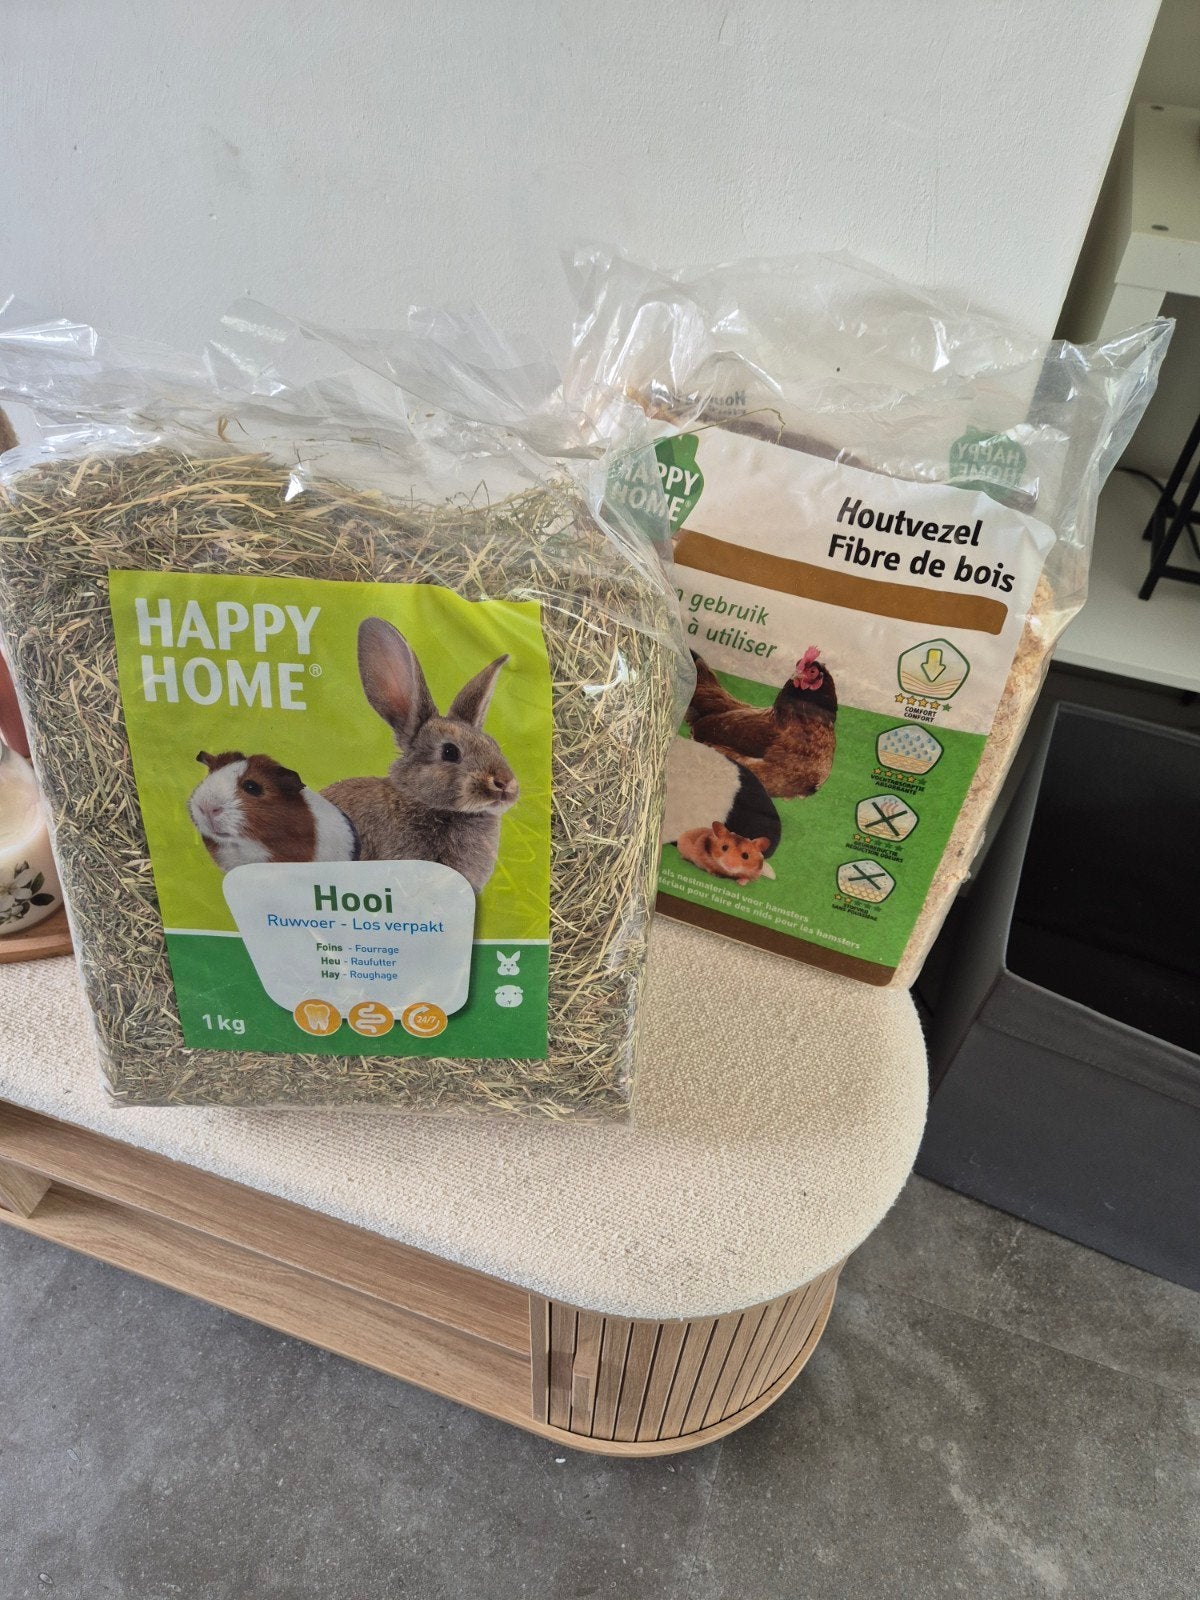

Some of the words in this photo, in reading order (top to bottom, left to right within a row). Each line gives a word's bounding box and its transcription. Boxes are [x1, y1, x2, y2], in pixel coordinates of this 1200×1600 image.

[836, 496, 983, 547] Houtvezel
[828, 534, 901, 571] Fibre
[909, 550, 946, 577] de
[954, 556, 1016, 593] bois
[688, 593, 770, 626] gebruik
[135, 597, 321, 655] HAPPY
[687, 617, 699, 636] à
[706, 627, 778, 658] utiliser
[903, 712, 935, 723] CONFORT
[904, 706, 937, 718] COMFORT
[314, 885, 393, 913] Hooi
[662, 868, 675, 878] als
[677, 875, 739, 900] nestmateriaal
[742, 896, 764, 907] voor
[766, 902, 810, 923] hamsters
[267, 914, 336, 929] Ruwvoer
[353, 918, 381, 931] Los
[385, 920, 445, 935] verpakt
[687, 886, 709, 899] pour
[712, 894, 732, 907] faire
[735, 902, 750, 913] des
[753, 909, 773, 920] nids
[775, 916, 798, 928] pour
[800, 923, 814, 934] les
[816, 929, 860, 949] hamsters
[316, 943, 343, 952] Foins
[355, 944, 399, 954] Fourrage
[321, 957, 341, 966] Heu
[351, 957, 397, 967] Raufutter
[321, 970, 340, 980] Hay
[350, 970, 398, 981] Roughage
[416, 1015, 436, 1023] 24/7
